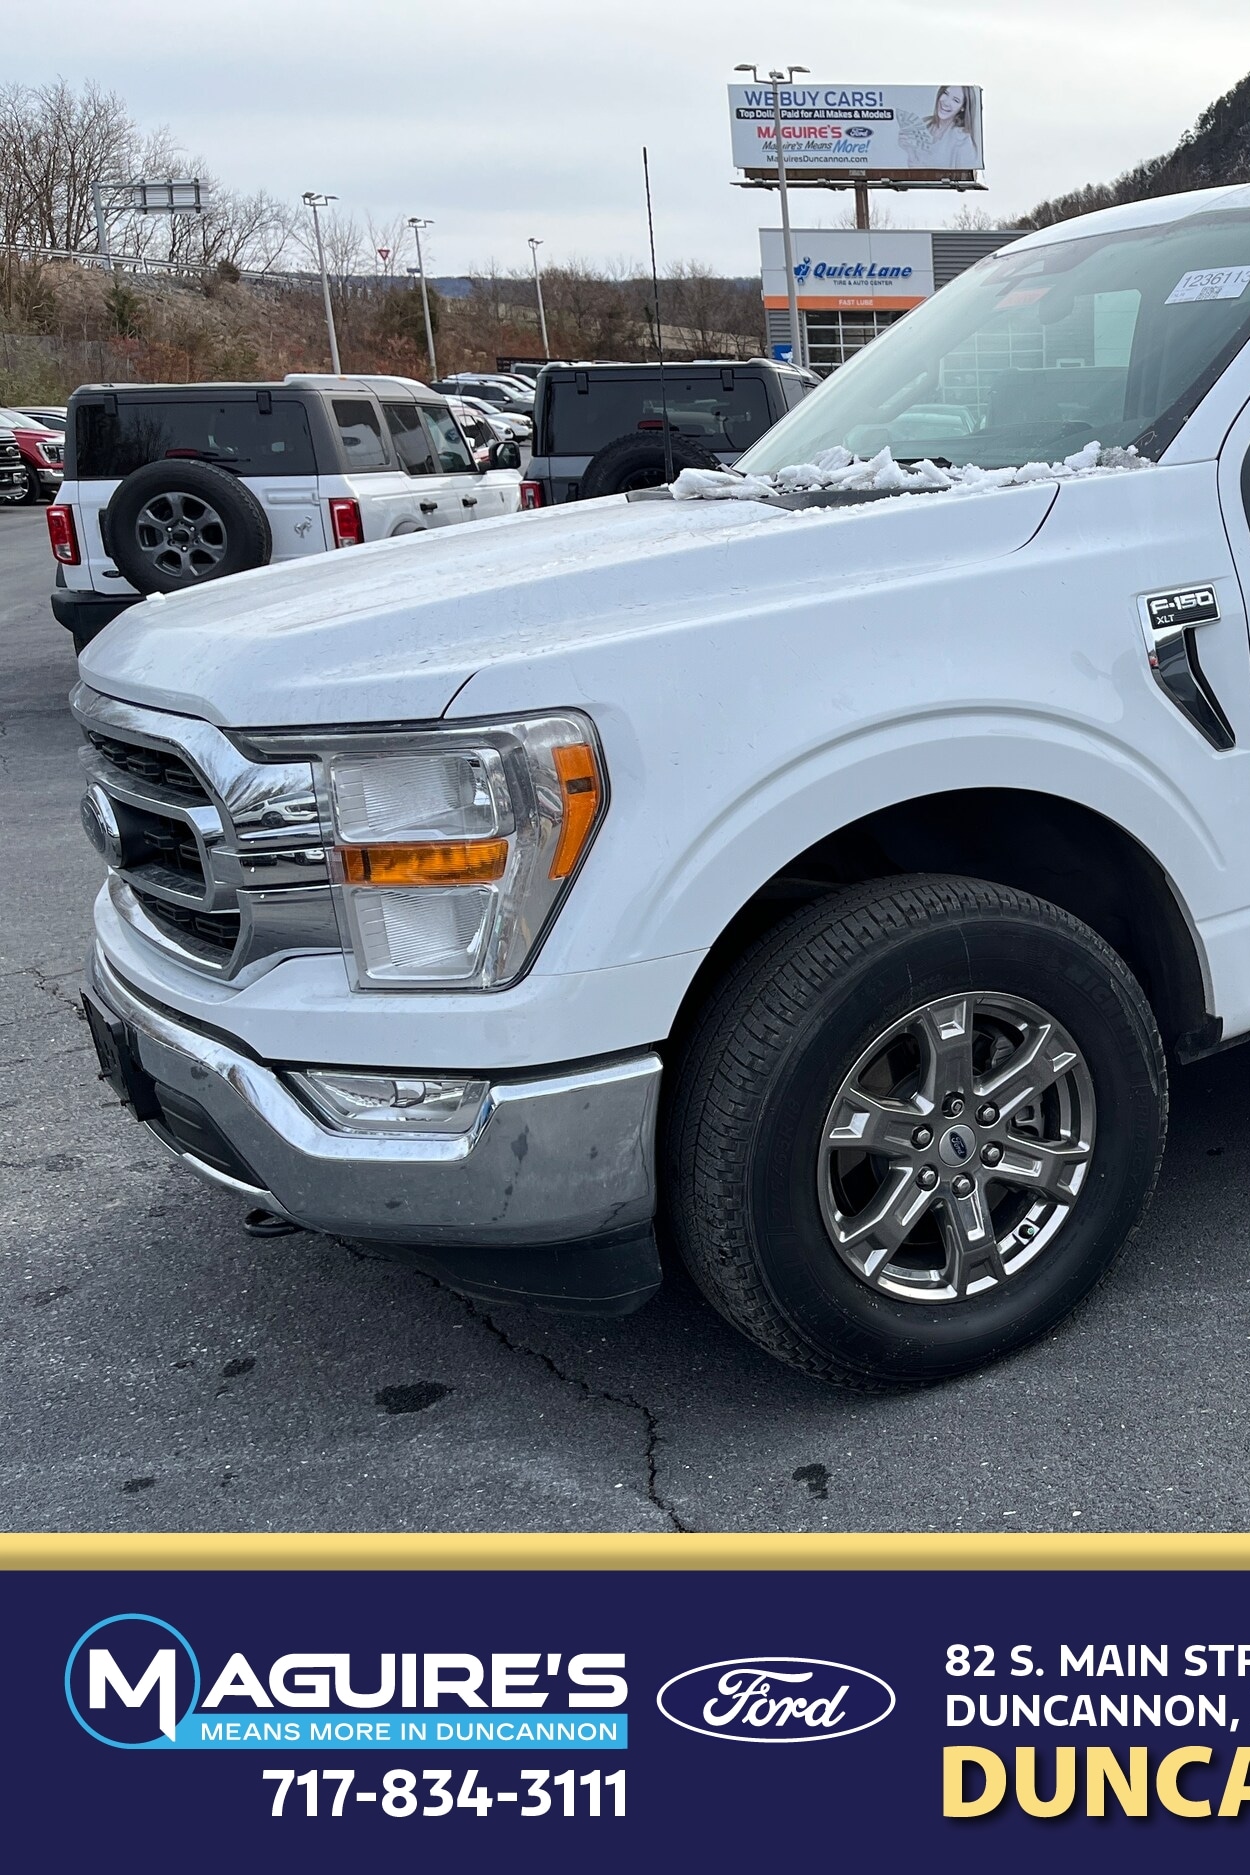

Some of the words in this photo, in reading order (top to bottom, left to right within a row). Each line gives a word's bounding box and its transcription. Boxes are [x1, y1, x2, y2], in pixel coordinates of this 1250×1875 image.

[744, 91, 774, 106] WE
[780, 91, 819, 106] BUY
[824, 91, 884, 107] CARS!
[739, 110, 755, 119] Top
[756, 110, 777, 118] Dolla
[781, 110, 800, 118] Paid
[801, 110, 813, 118] for
[814, 110, 825, 118] All
[826, 110, 852, 118] Makes
[853, 110, 860, 118] &
[861, 111, 892, 119] Models
[849, 127, 870, 137] Ford
[762, 141, 803, 150] Mauire's
[805, 141, 833, 150] Means
[832, 140, 871, 153] More!
[766, 155, 868, 163] MauiresDuncannon.com
[813, 262, 867, 279] Quick
[867, 262, 912, 278] Lane
[1150, 590, 1214, 614] F-150
[1156, 614, 1175, 625] XLT
